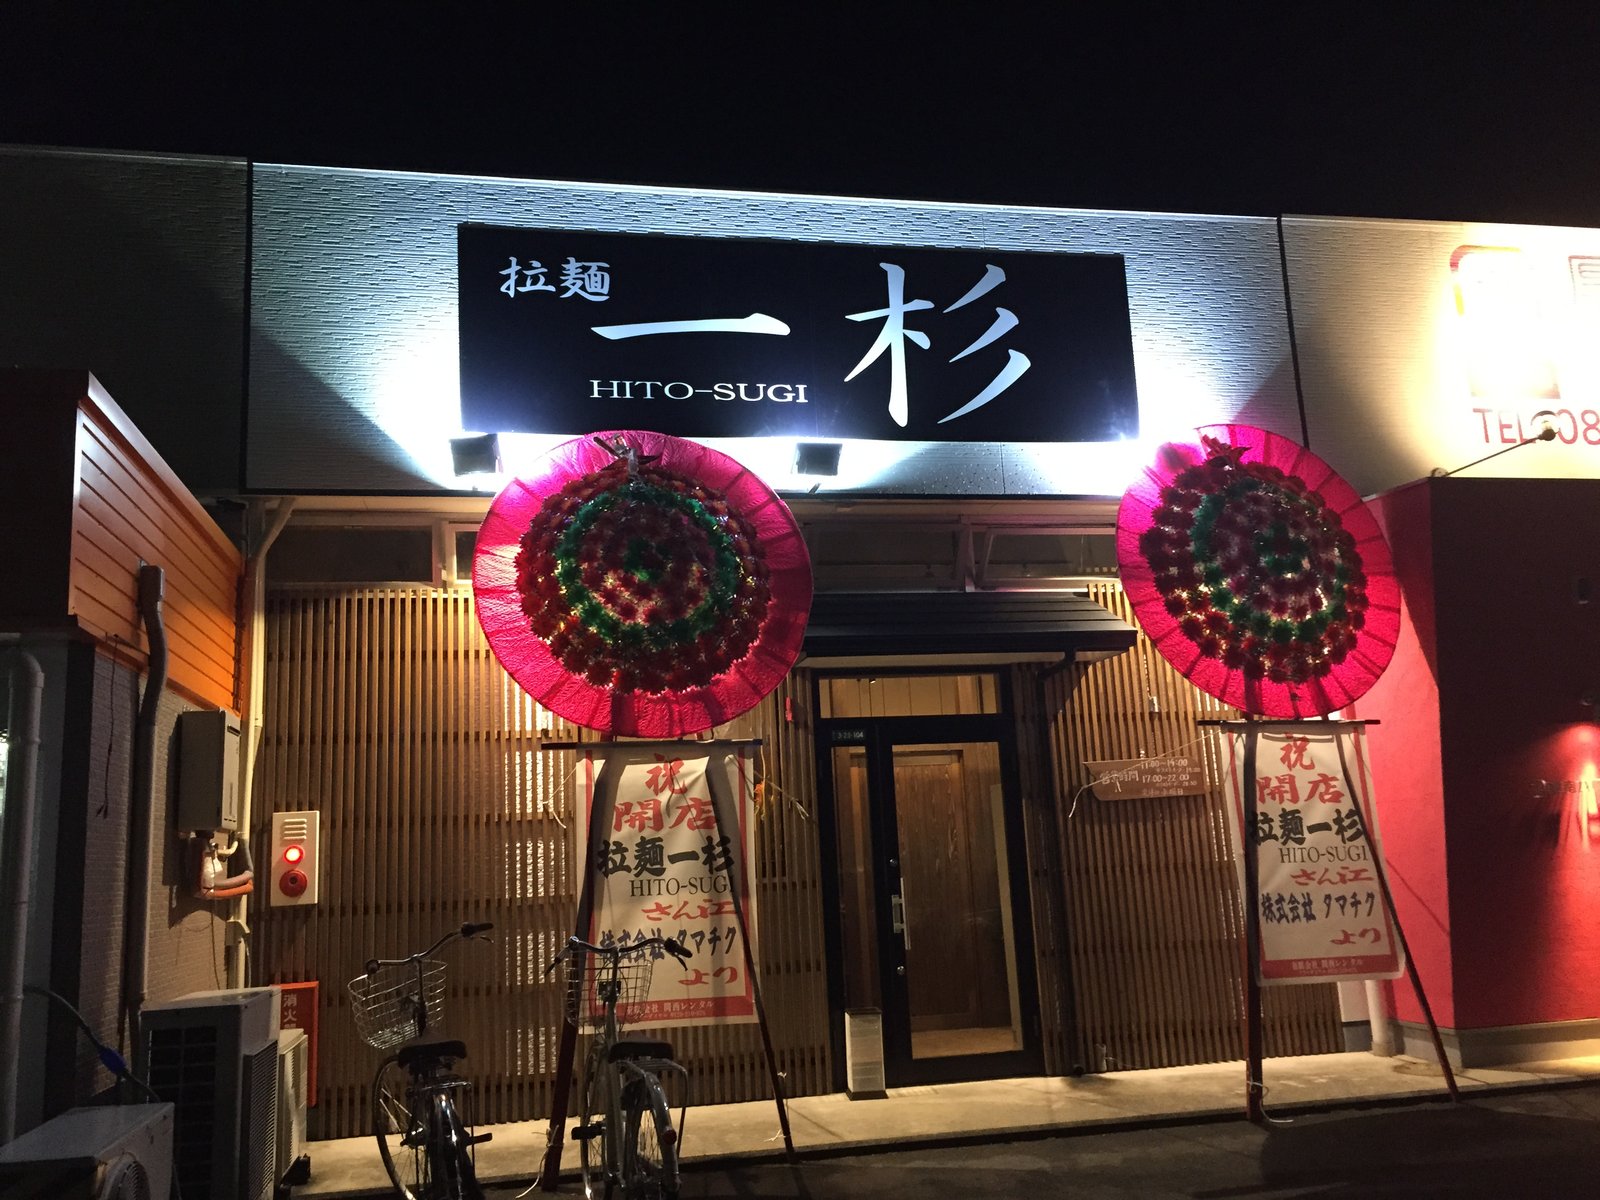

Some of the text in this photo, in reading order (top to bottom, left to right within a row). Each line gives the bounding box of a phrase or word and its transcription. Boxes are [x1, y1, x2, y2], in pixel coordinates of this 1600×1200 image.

[499, 256, 611, 302] 拉麺
[589, 380, 809, 403] HITO-SUGI
[1280, 732, 1315, 771] 祝
[645, 753, 687, 796] 祝
[1256, 773, 1344, 804] 開店
[613, 797, 716, 833] 開店
[1280, 845, 1368, 863] HITO-SUGI
[629, 875, 734, 897] HITO-SUGI
[1261, 891, 1376, 924] 株式会社 タマチク
